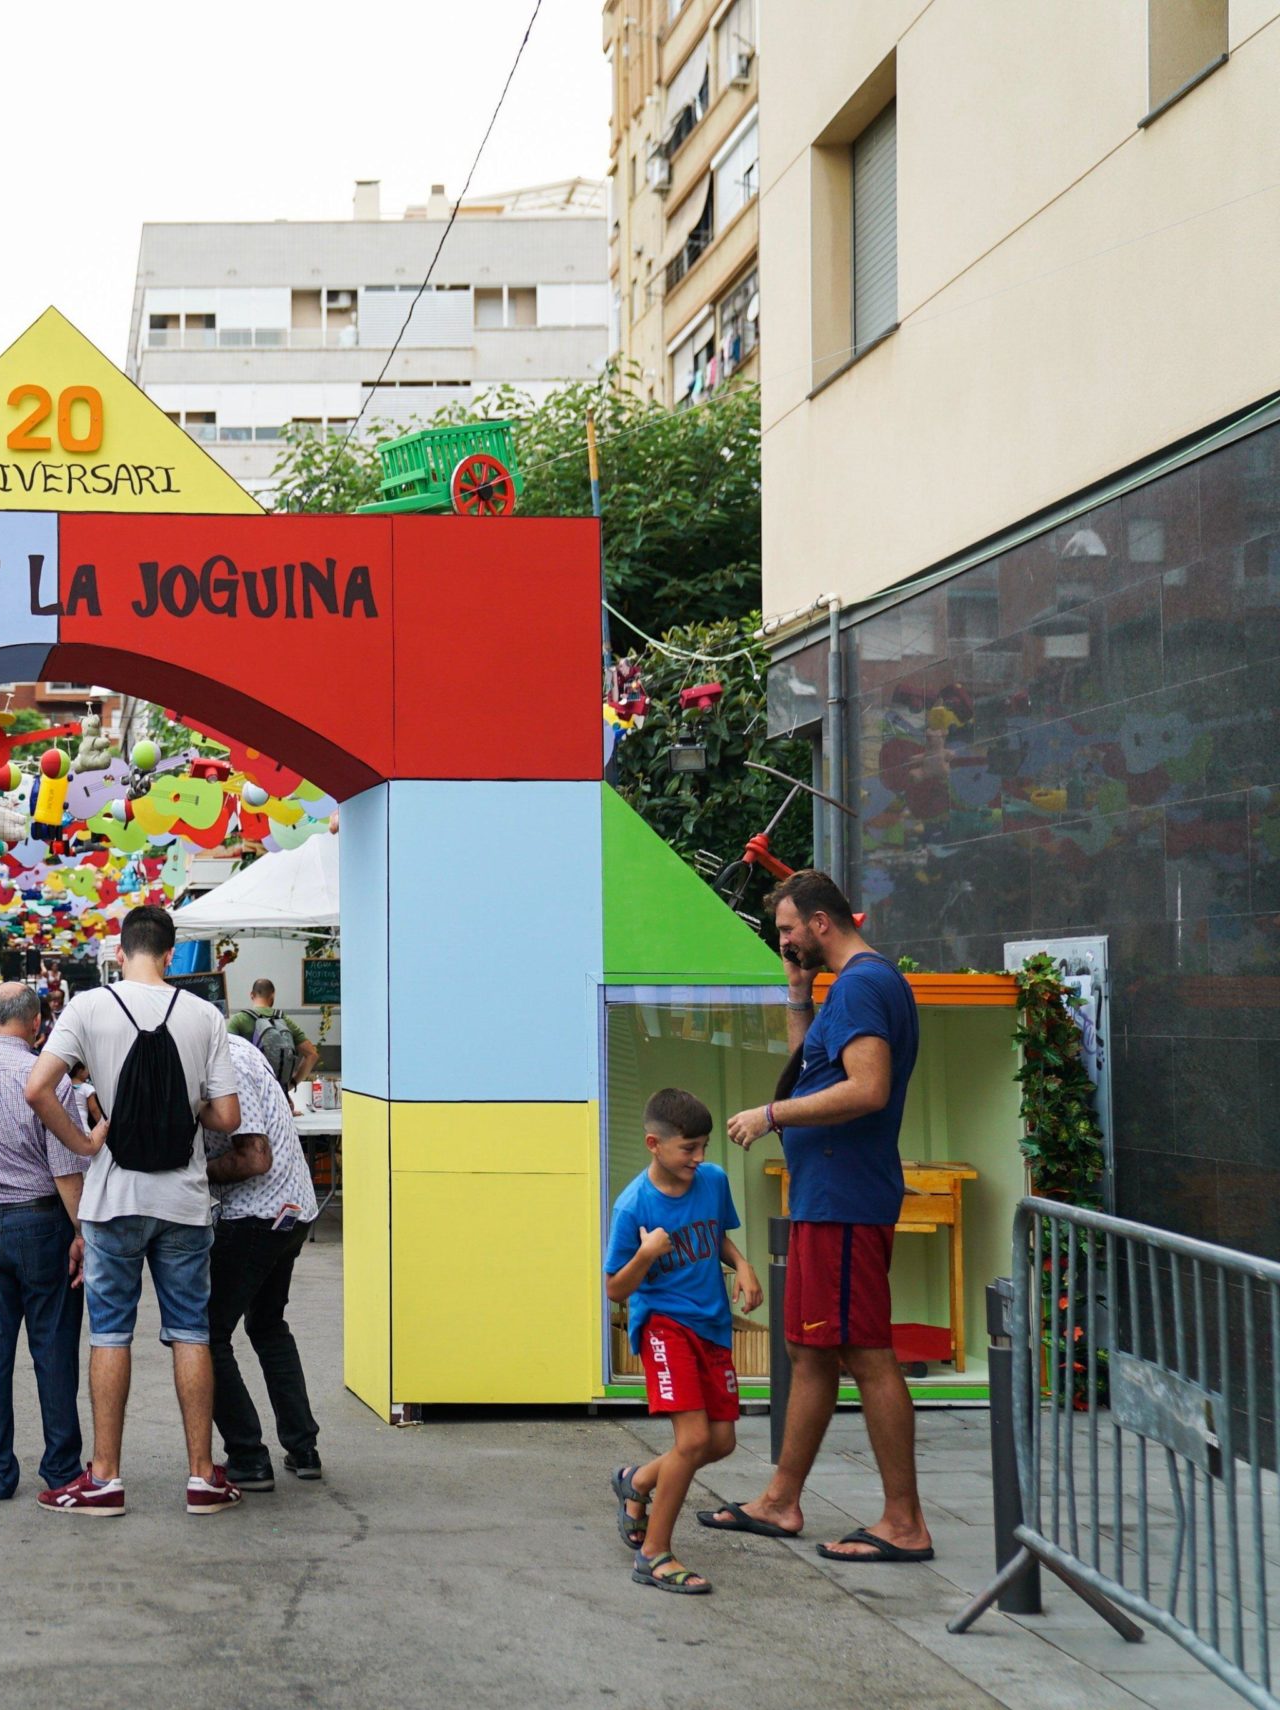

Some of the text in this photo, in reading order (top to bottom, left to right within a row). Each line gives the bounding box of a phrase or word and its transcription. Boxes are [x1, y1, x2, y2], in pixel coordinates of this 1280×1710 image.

[7, 384, 103, 452] 20
[28, 555, 102, 617] LA
[131, 555, 379, 619] JOGUINA
